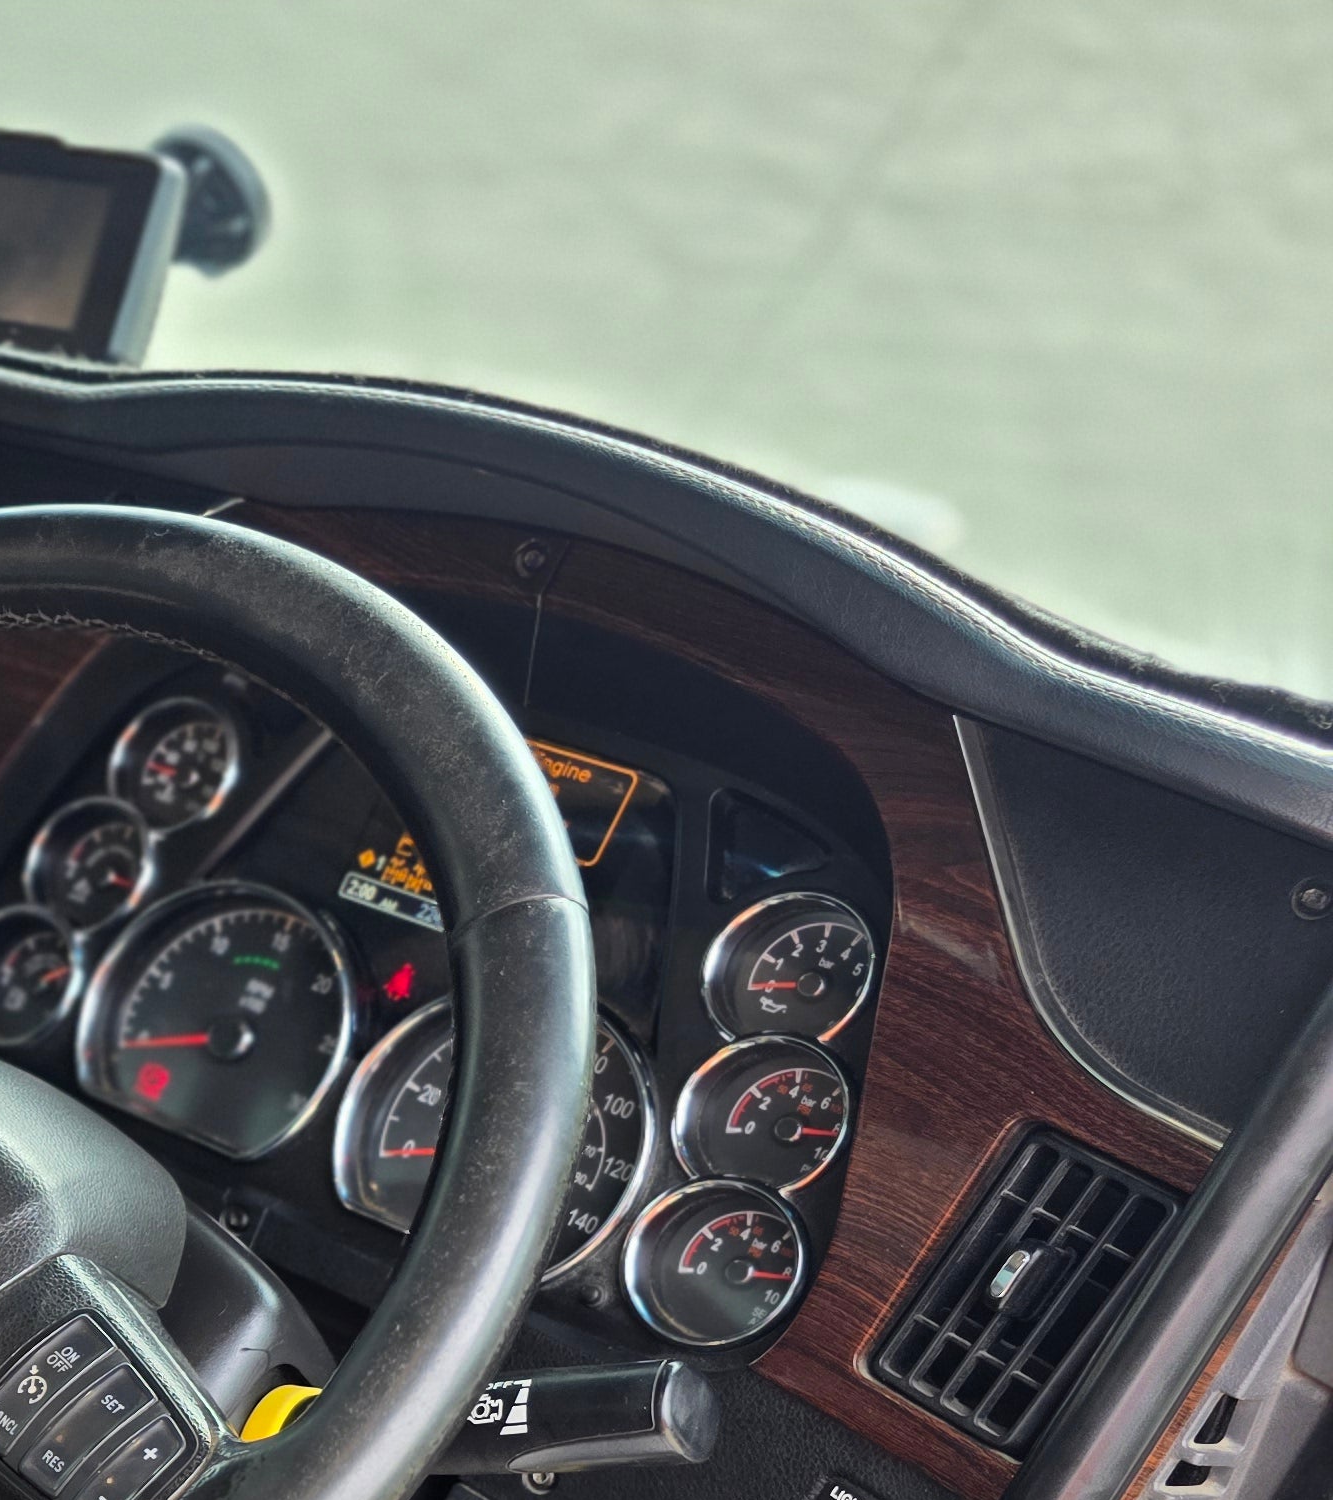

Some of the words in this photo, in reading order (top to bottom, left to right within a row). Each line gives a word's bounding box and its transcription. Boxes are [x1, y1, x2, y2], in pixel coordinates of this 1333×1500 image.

[791, 943, 803, 957] 2
[816, 939, 827, 953] 3
[840, 947, 852, 961] 4
[775, 957, 784, 971] 1
[818, 957, 834, 970] bar
[852, 963, 864, 976] 5
[417, 1083, 441, 1106] 20
[788, 1085, 800, 1098] 4
[603, 1093, 635, 1119] 100
[759, 1097, 771, 1111] 2
[800, 1095, 817, 1107] bar
[820, 1097, 831, 1110] 6
[744, 1121, 755, 1134] 0
[604, 1156, 635, 1182] 120
[567, 1208, 599, 1234] 140
[740, 1227, 751, 1240] 4
[710, 1237, 723, 1251] 2
[771, 1240, 781, 1253] 6
[696, 1261, 707, 1275] 0
[764, 1289, 780, 1305] 10
[61, 1346, 81, 1363] ON
[46, 1353, 69, 1373] OFF
[101, 1394, 125, 1415] SET
[42, 1450, 65, 1473] RES
